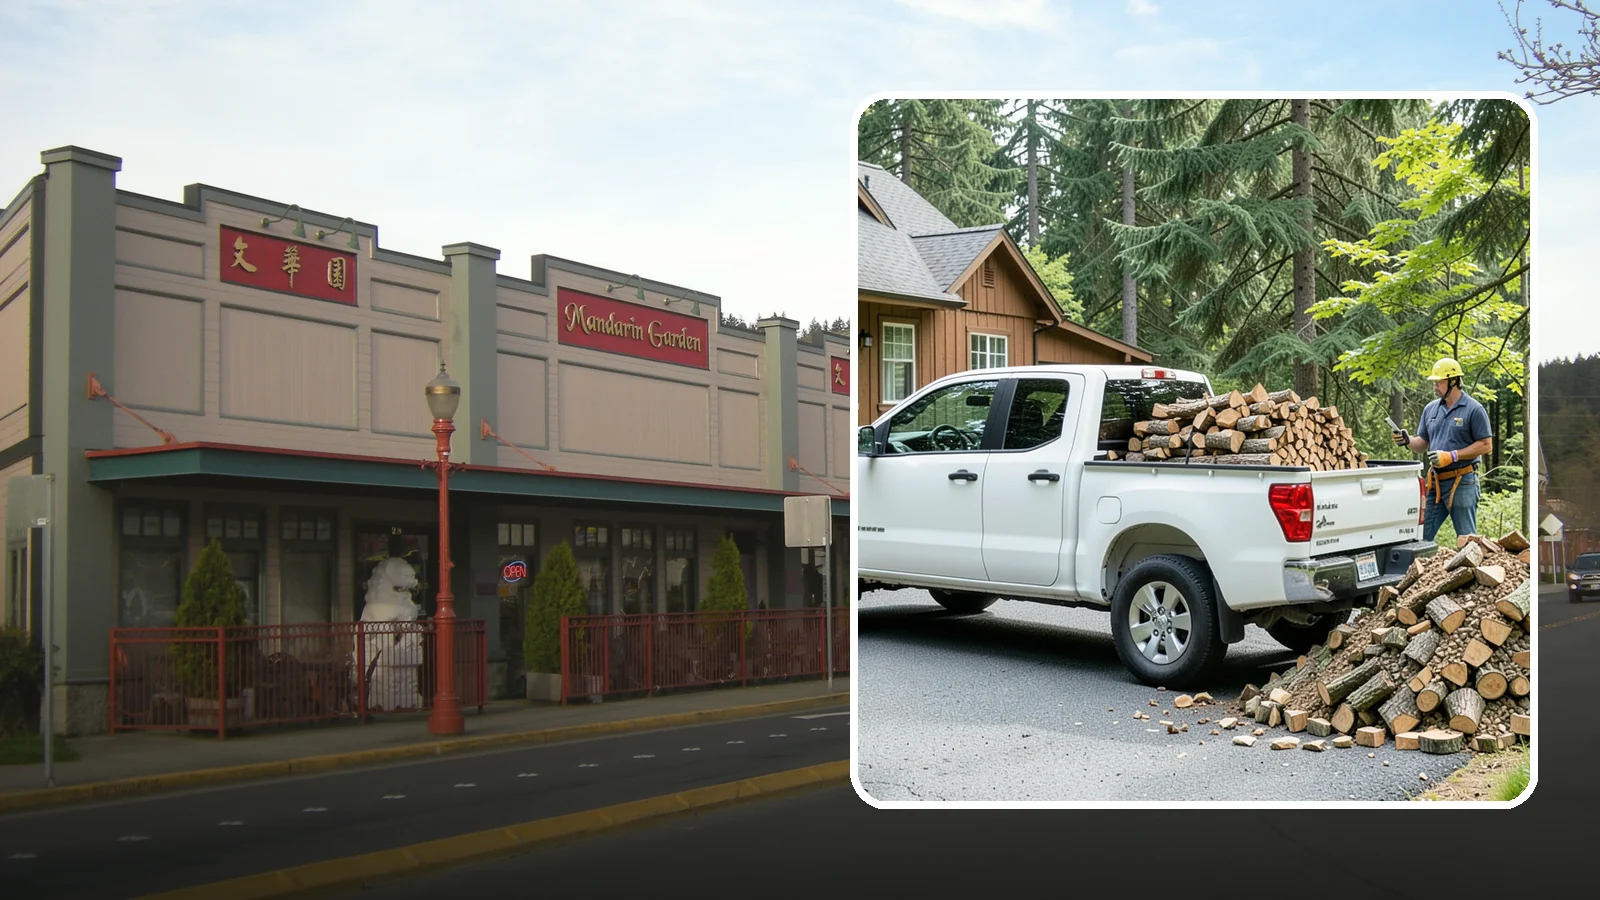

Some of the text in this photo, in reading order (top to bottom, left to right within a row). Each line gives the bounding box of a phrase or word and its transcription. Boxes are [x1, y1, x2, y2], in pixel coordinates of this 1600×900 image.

[231, 235, 346, 291] 文華園
[564, 302, 702, 352] Mandarin Garden
[503, 565, 527, 578] OPEN
